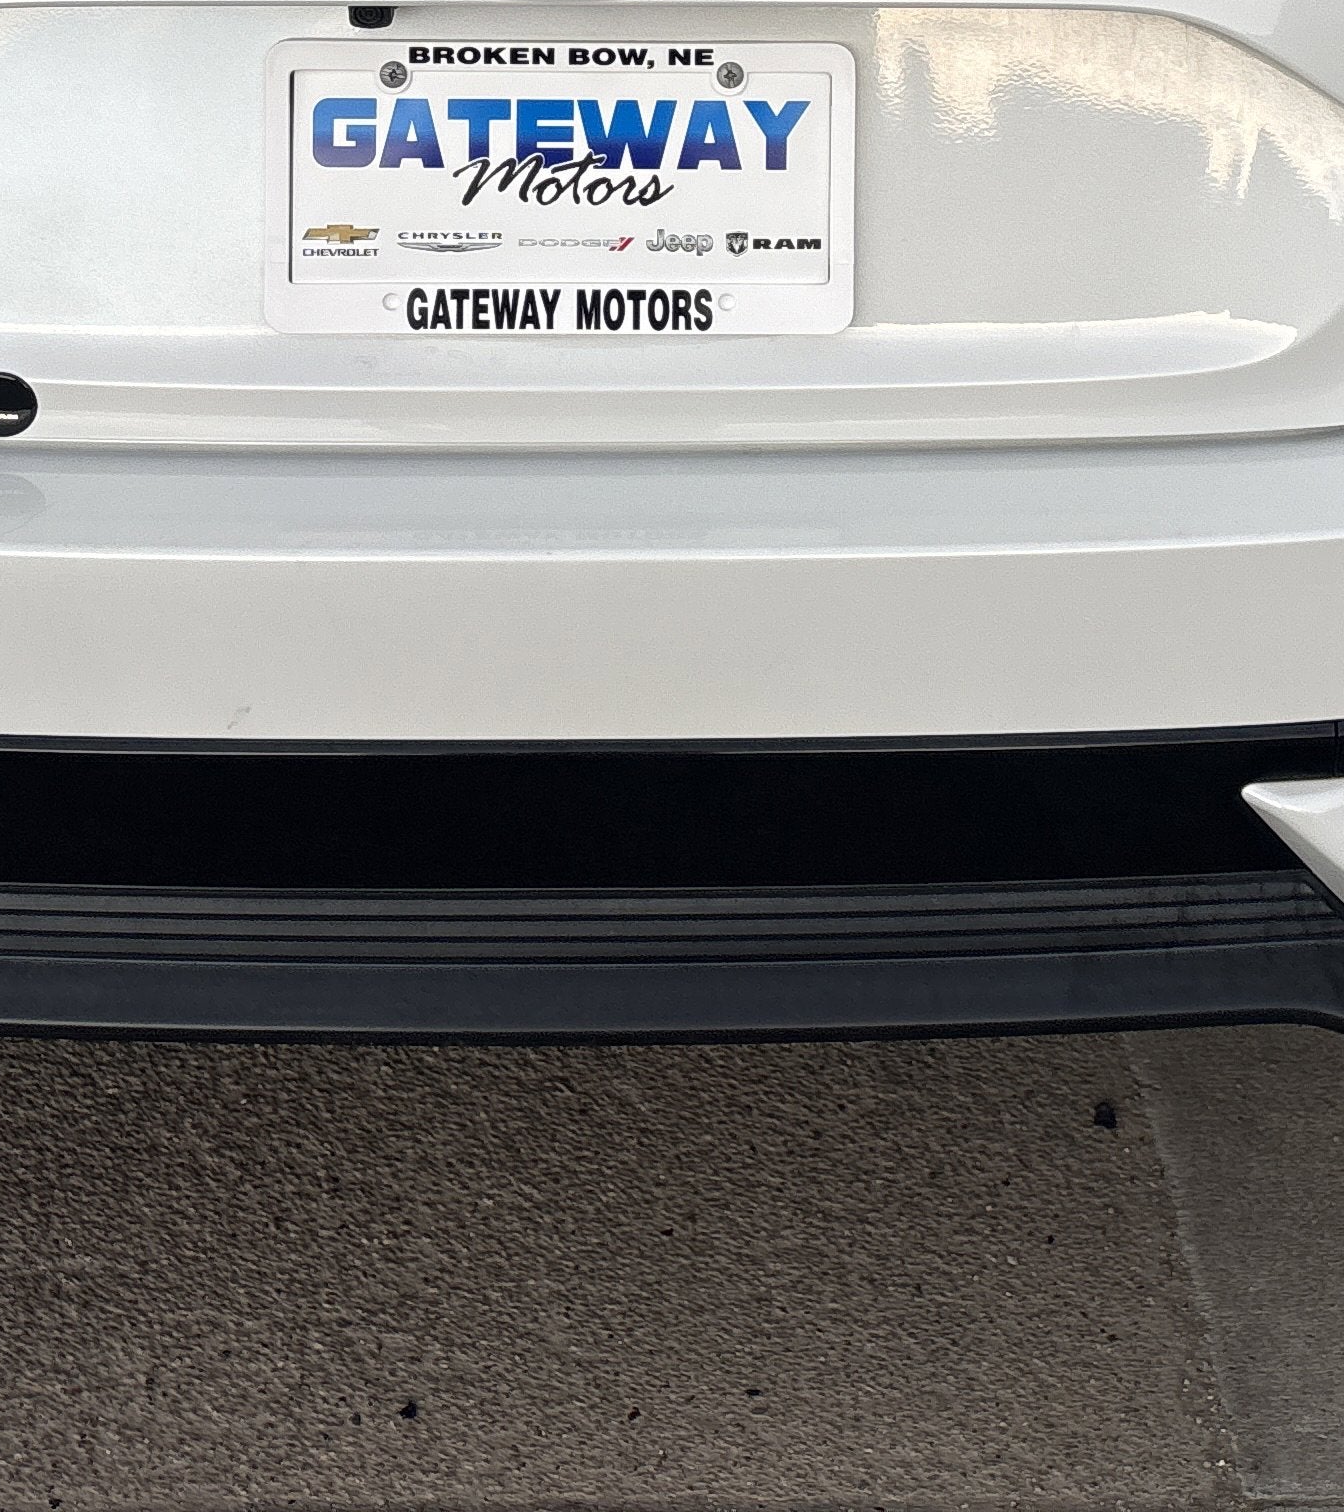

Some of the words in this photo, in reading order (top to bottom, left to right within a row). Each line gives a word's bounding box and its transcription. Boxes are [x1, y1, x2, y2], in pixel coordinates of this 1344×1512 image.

[409, 47, 554, 65] BROKEN
[569, 48, 654, 69] BOW,
[669, 49, 714, 66] NE
[312, 97, 811, 171] GATEWAY
[453, 152, 674, 207] Motors
[397, 232, 503, 240] CHRYSLER
[518, 238, 619, 248] DODGE
[645, 228, 714, 256] Jeep
[752, 238, 822, 250] RAM
[302, 248, 379, 257] CHEVROLET
[407, 288, 558, 331] GATEWAY
[577, 289, 713, 331] MOTORS
